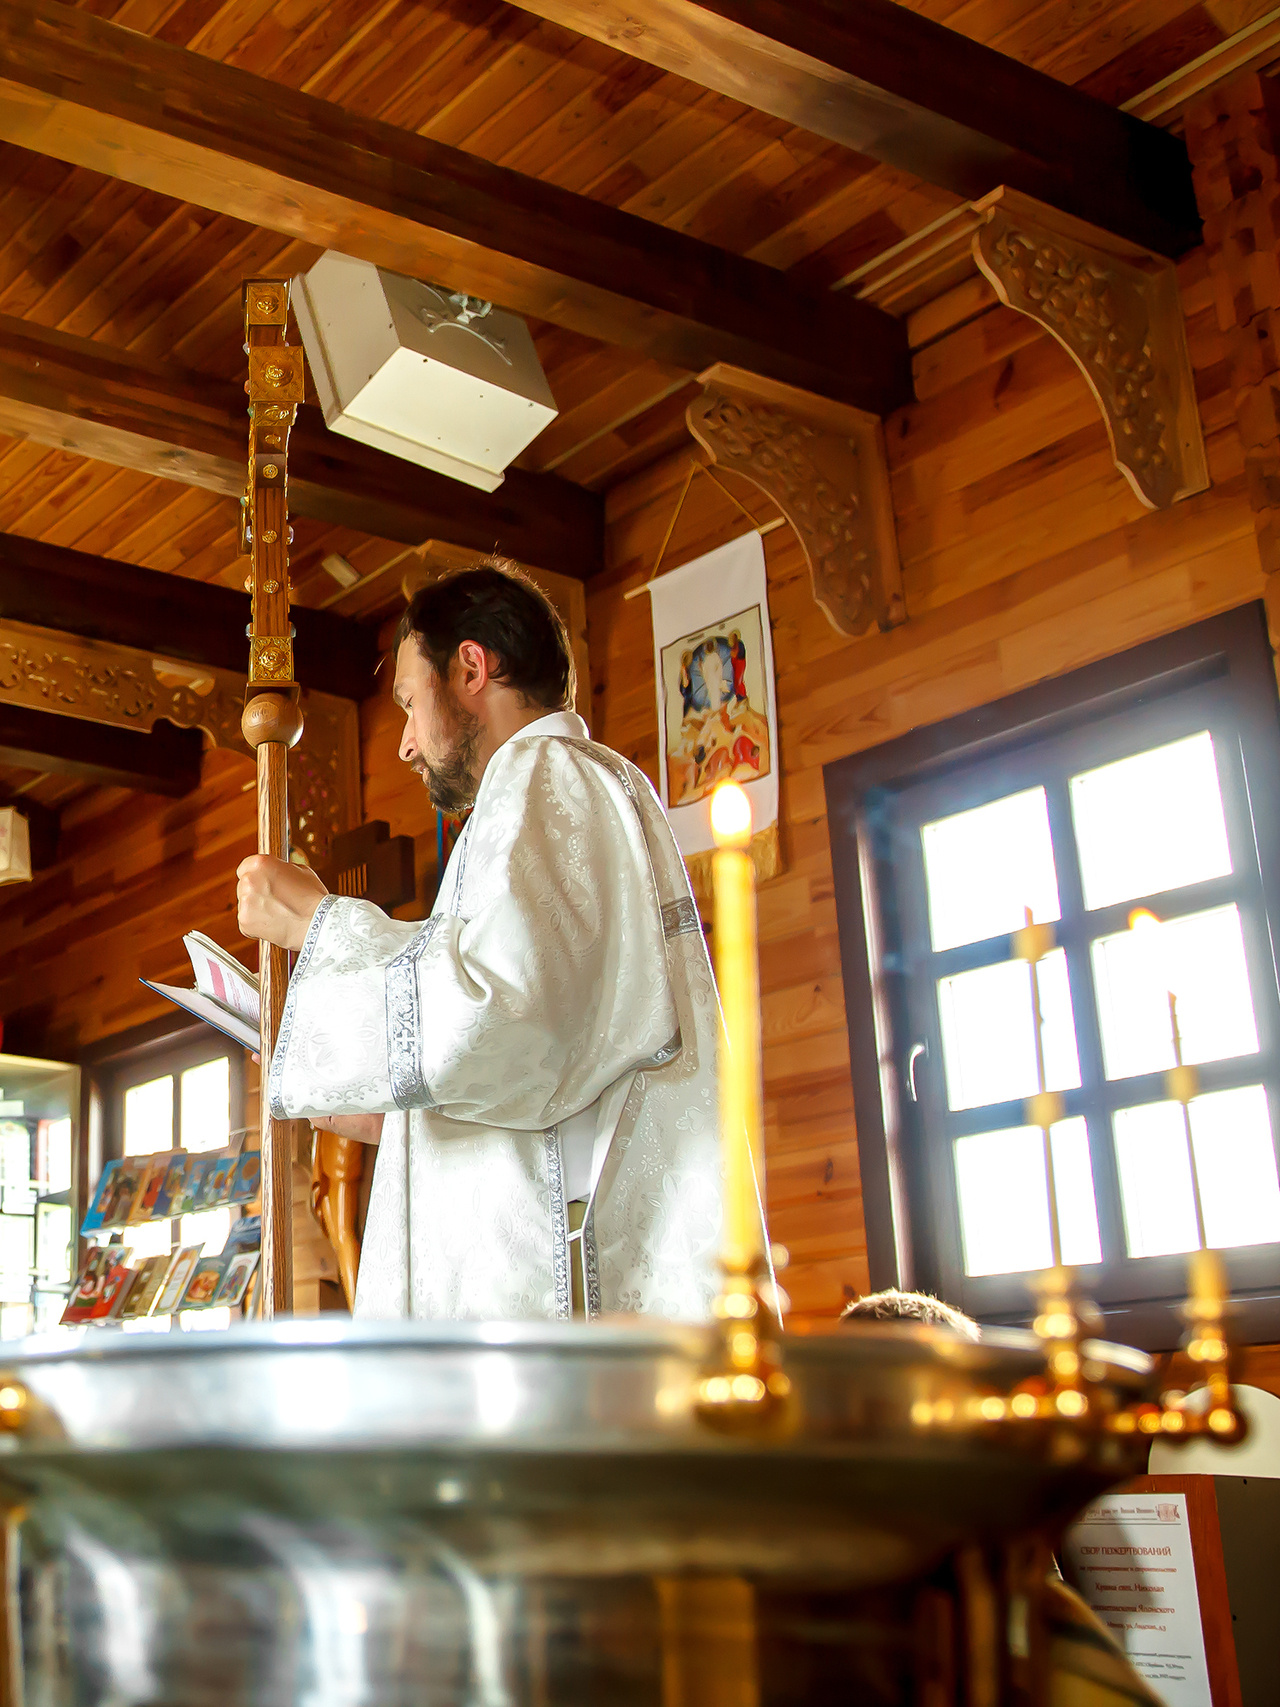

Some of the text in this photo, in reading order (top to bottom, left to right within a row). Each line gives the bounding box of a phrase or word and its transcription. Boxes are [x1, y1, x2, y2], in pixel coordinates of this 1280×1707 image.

[1080, 1545, 1172, 1557] СБОР ПОЖЕРТВОВАНИЙ
[1138, 1603, 1176, 1614] Японского
